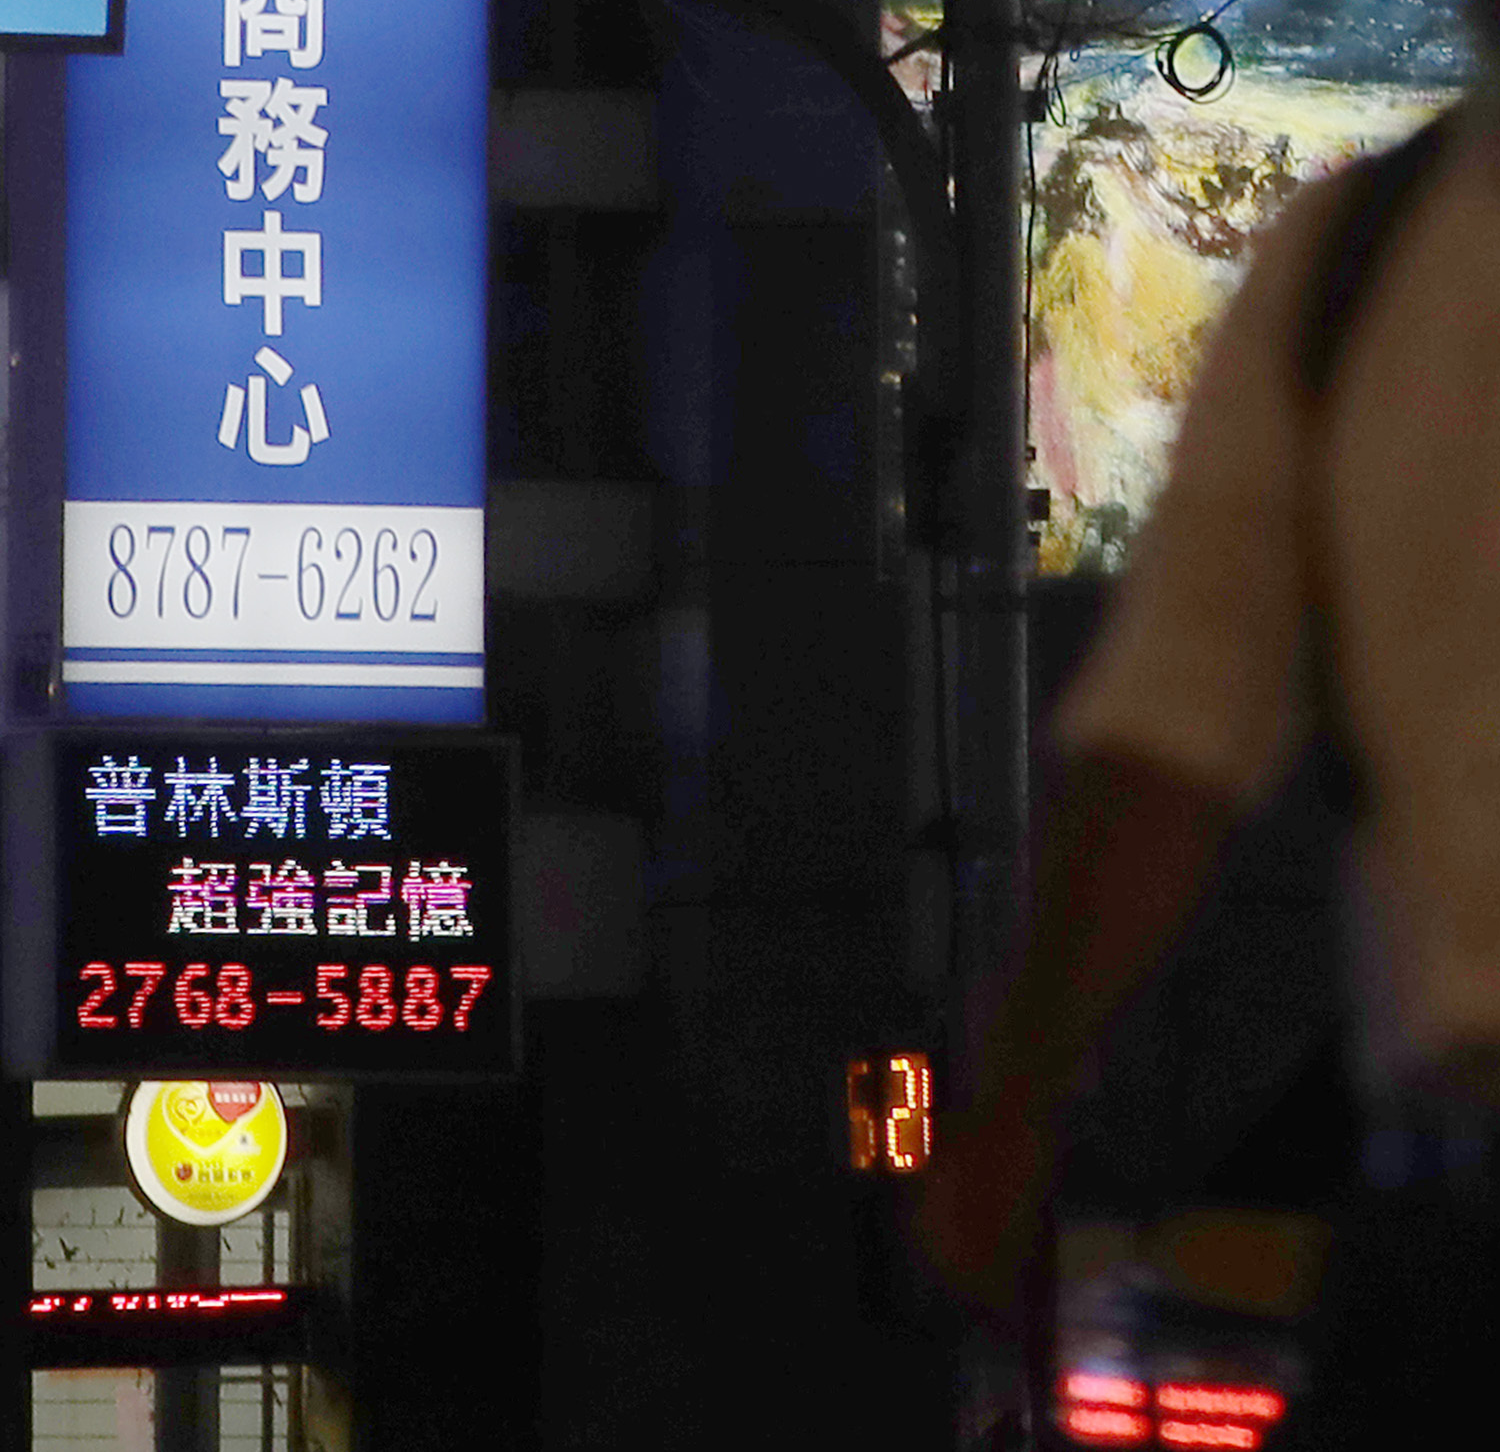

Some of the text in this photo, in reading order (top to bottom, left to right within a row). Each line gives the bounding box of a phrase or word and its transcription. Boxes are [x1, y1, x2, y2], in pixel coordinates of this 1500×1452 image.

[106, 522, 440, 624] 8787-6262
[84, 754, 394, 841] 普林斯頓
[166, 855, 475, 943] 超強記憶
[77, 960, 493, 1033] 2768-5887
